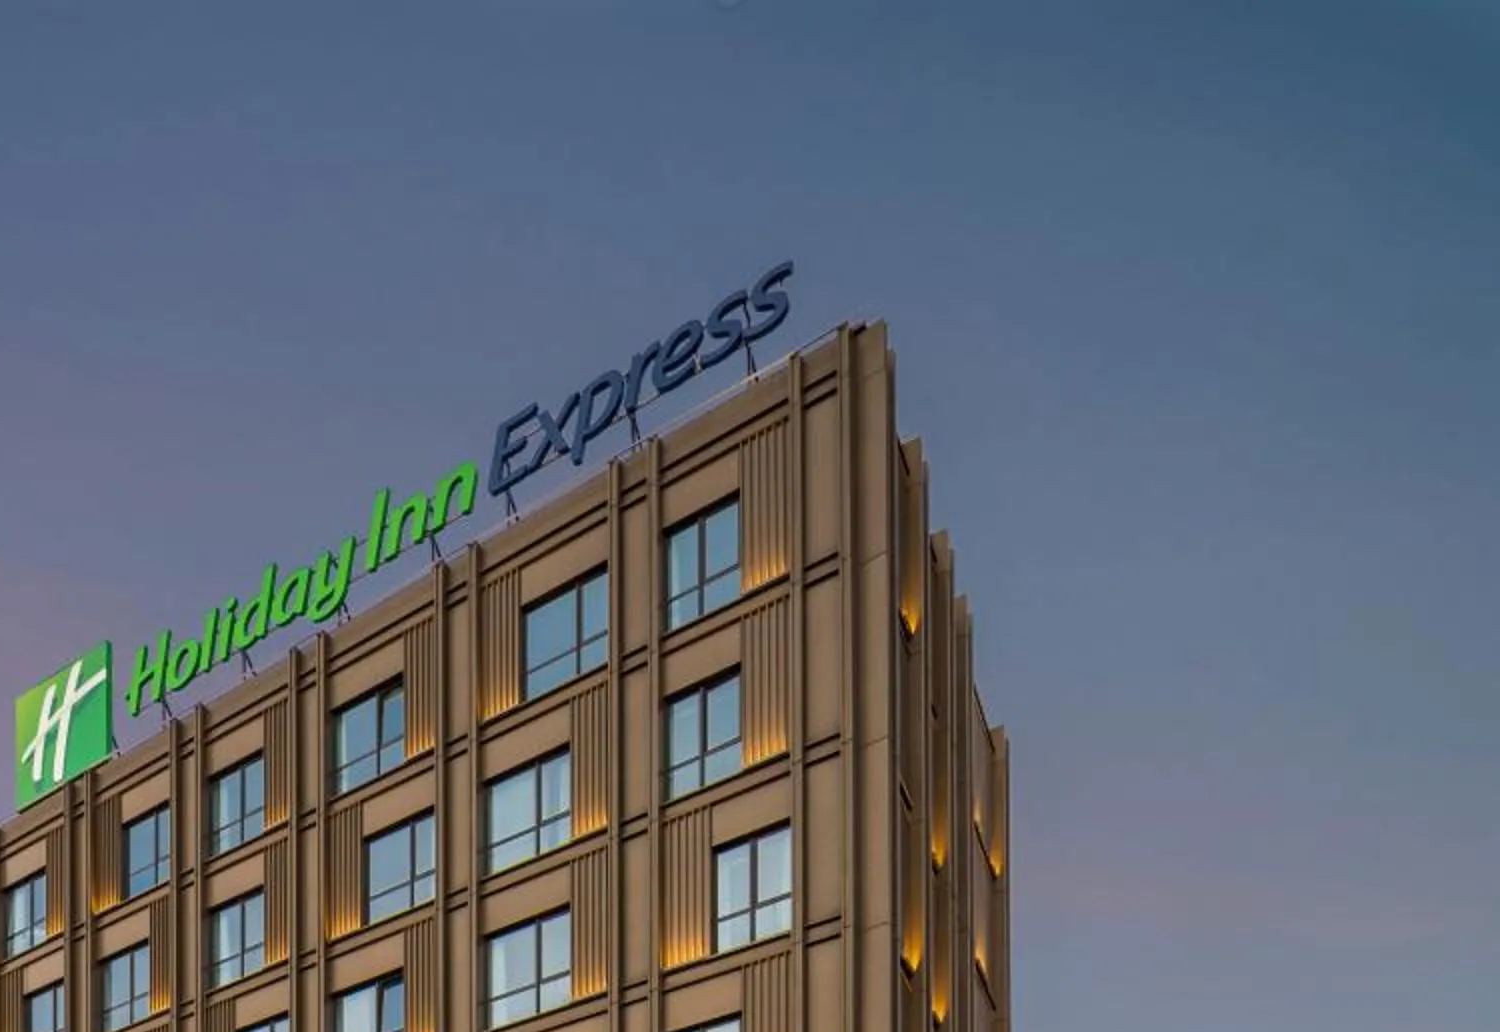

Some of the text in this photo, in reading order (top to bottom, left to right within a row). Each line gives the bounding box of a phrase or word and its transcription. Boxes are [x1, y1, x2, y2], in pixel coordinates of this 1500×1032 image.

[125, 259, 795, 717] Holiday Inn Express
